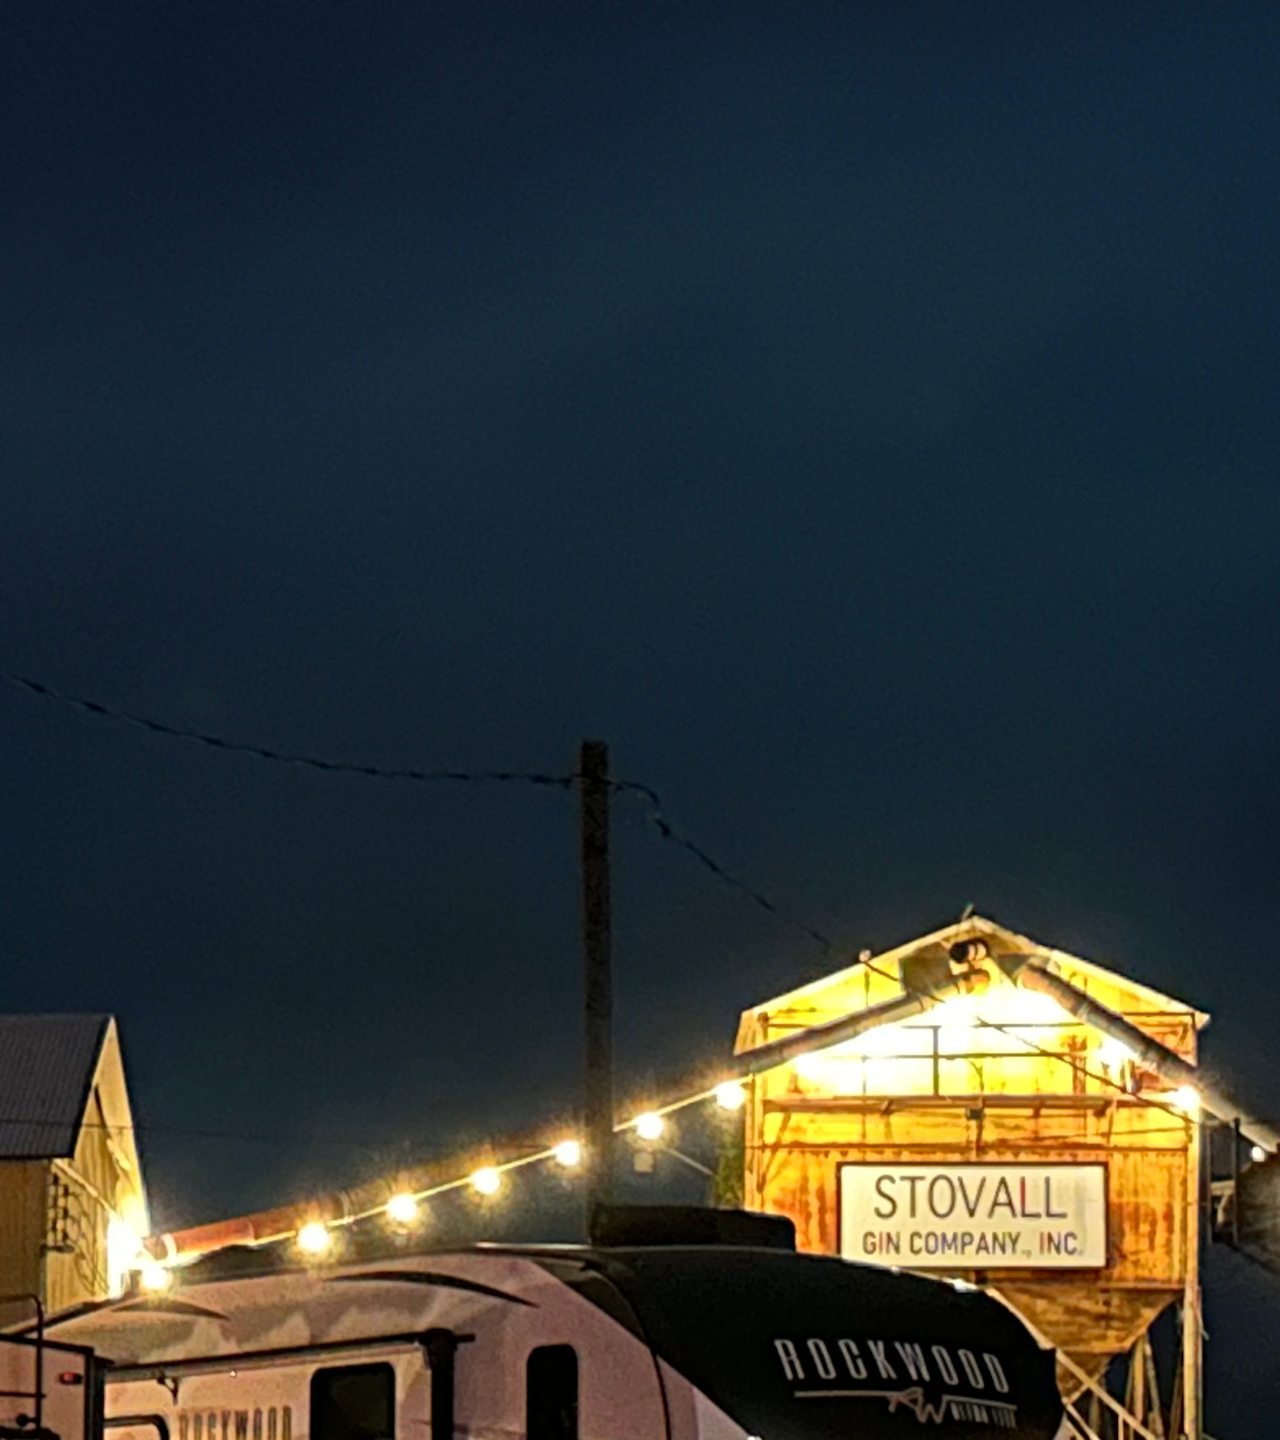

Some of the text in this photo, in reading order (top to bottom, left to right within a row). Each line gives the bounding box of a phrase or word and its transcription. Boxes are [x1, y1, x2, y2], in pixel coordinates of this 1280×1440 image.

[873, 1174, 1068, 1219] STOVALL
[862, 1231, 902, 1255] GIN
[1039, 1231, 1084, 1256] INC.
[773, 1338, 1010, 1394] ROCKWOOD
